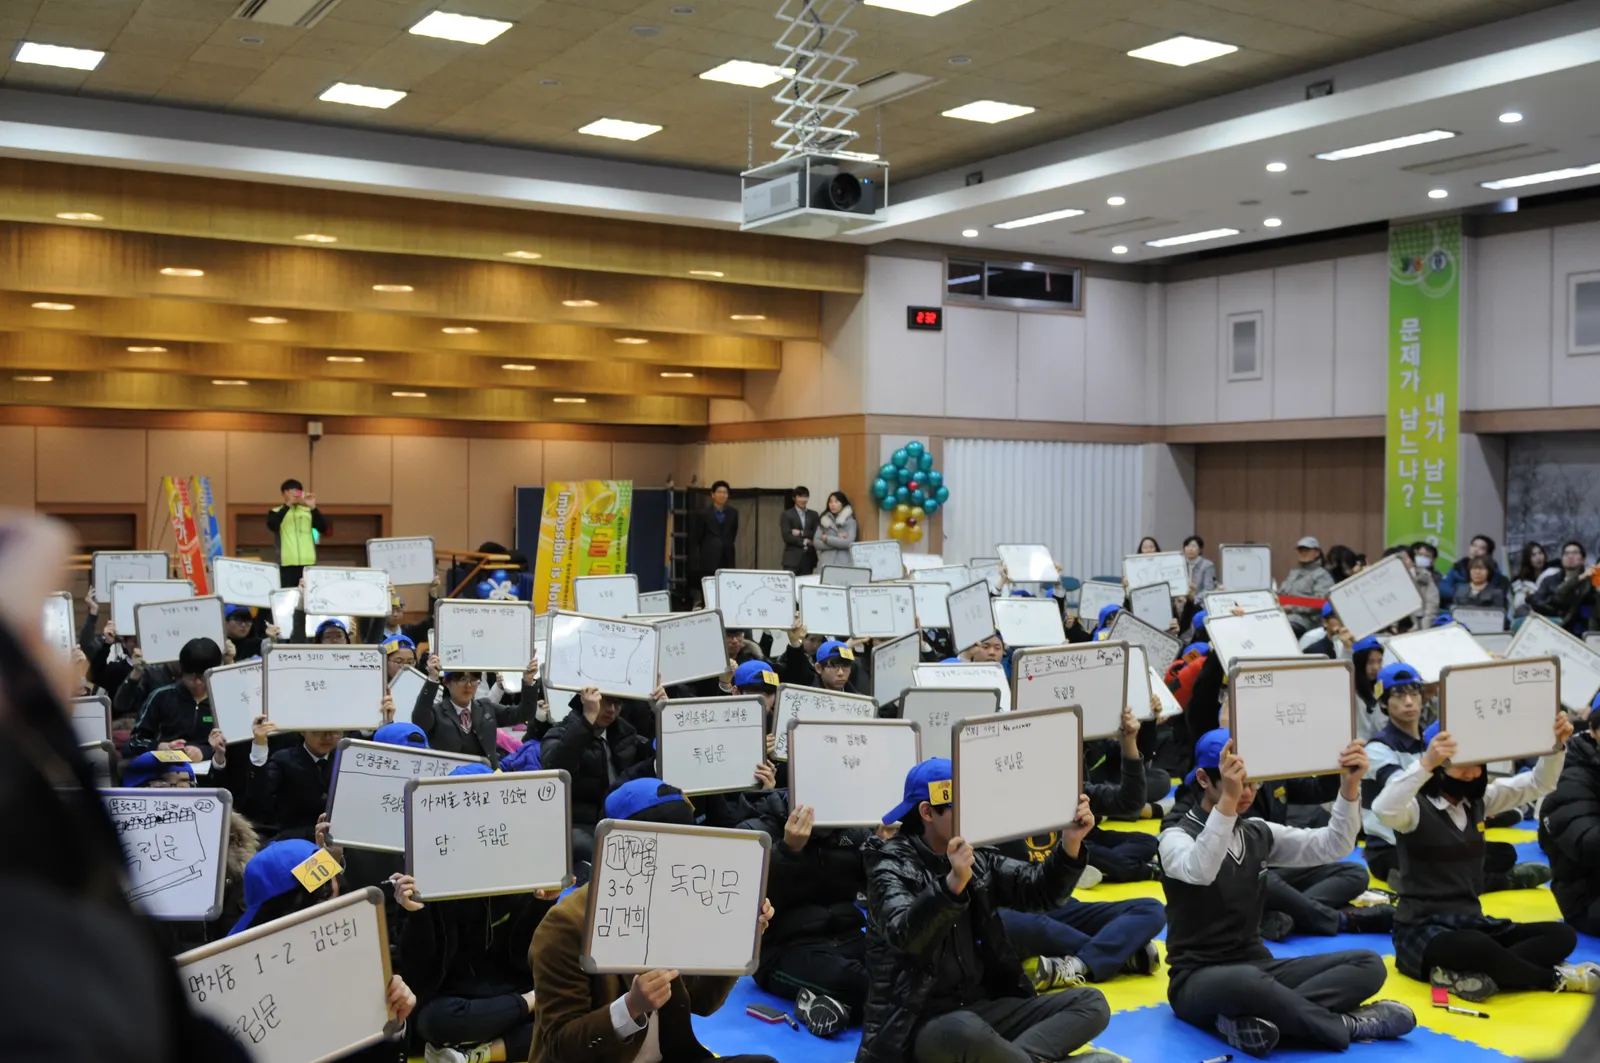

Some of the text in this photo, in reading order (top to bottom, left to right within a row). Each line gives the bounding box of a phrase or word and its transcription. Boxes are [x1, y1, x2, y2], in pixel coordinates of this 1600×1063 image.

[1397, 317, 1421, 508] 문제가 남느냐?
[1425, 392, 1446, 443] 내가
[553, 491, 572, 564] Impossible
[550, 567, 565, 579] is
[1011, 722, 1032, 731] answer
[692, 743, 726, 765] 독립문
[994, 751, 1024, 773] 독립문
[420, 789, 461, 812] 가재울
[462, 790, 491, 807] 중학교
[499, 787, 528, 805] 김소현
[476, 822, 509, 847] 독립문
[308, 864, 330, 884] 10
[607, 877, 634, 897] 3-6
[670, 864, 740, 915] 독립문
[597, 904, 646, 937] 김건희
[188, 917, 358, 1003] 명지중 1-2 김단희
